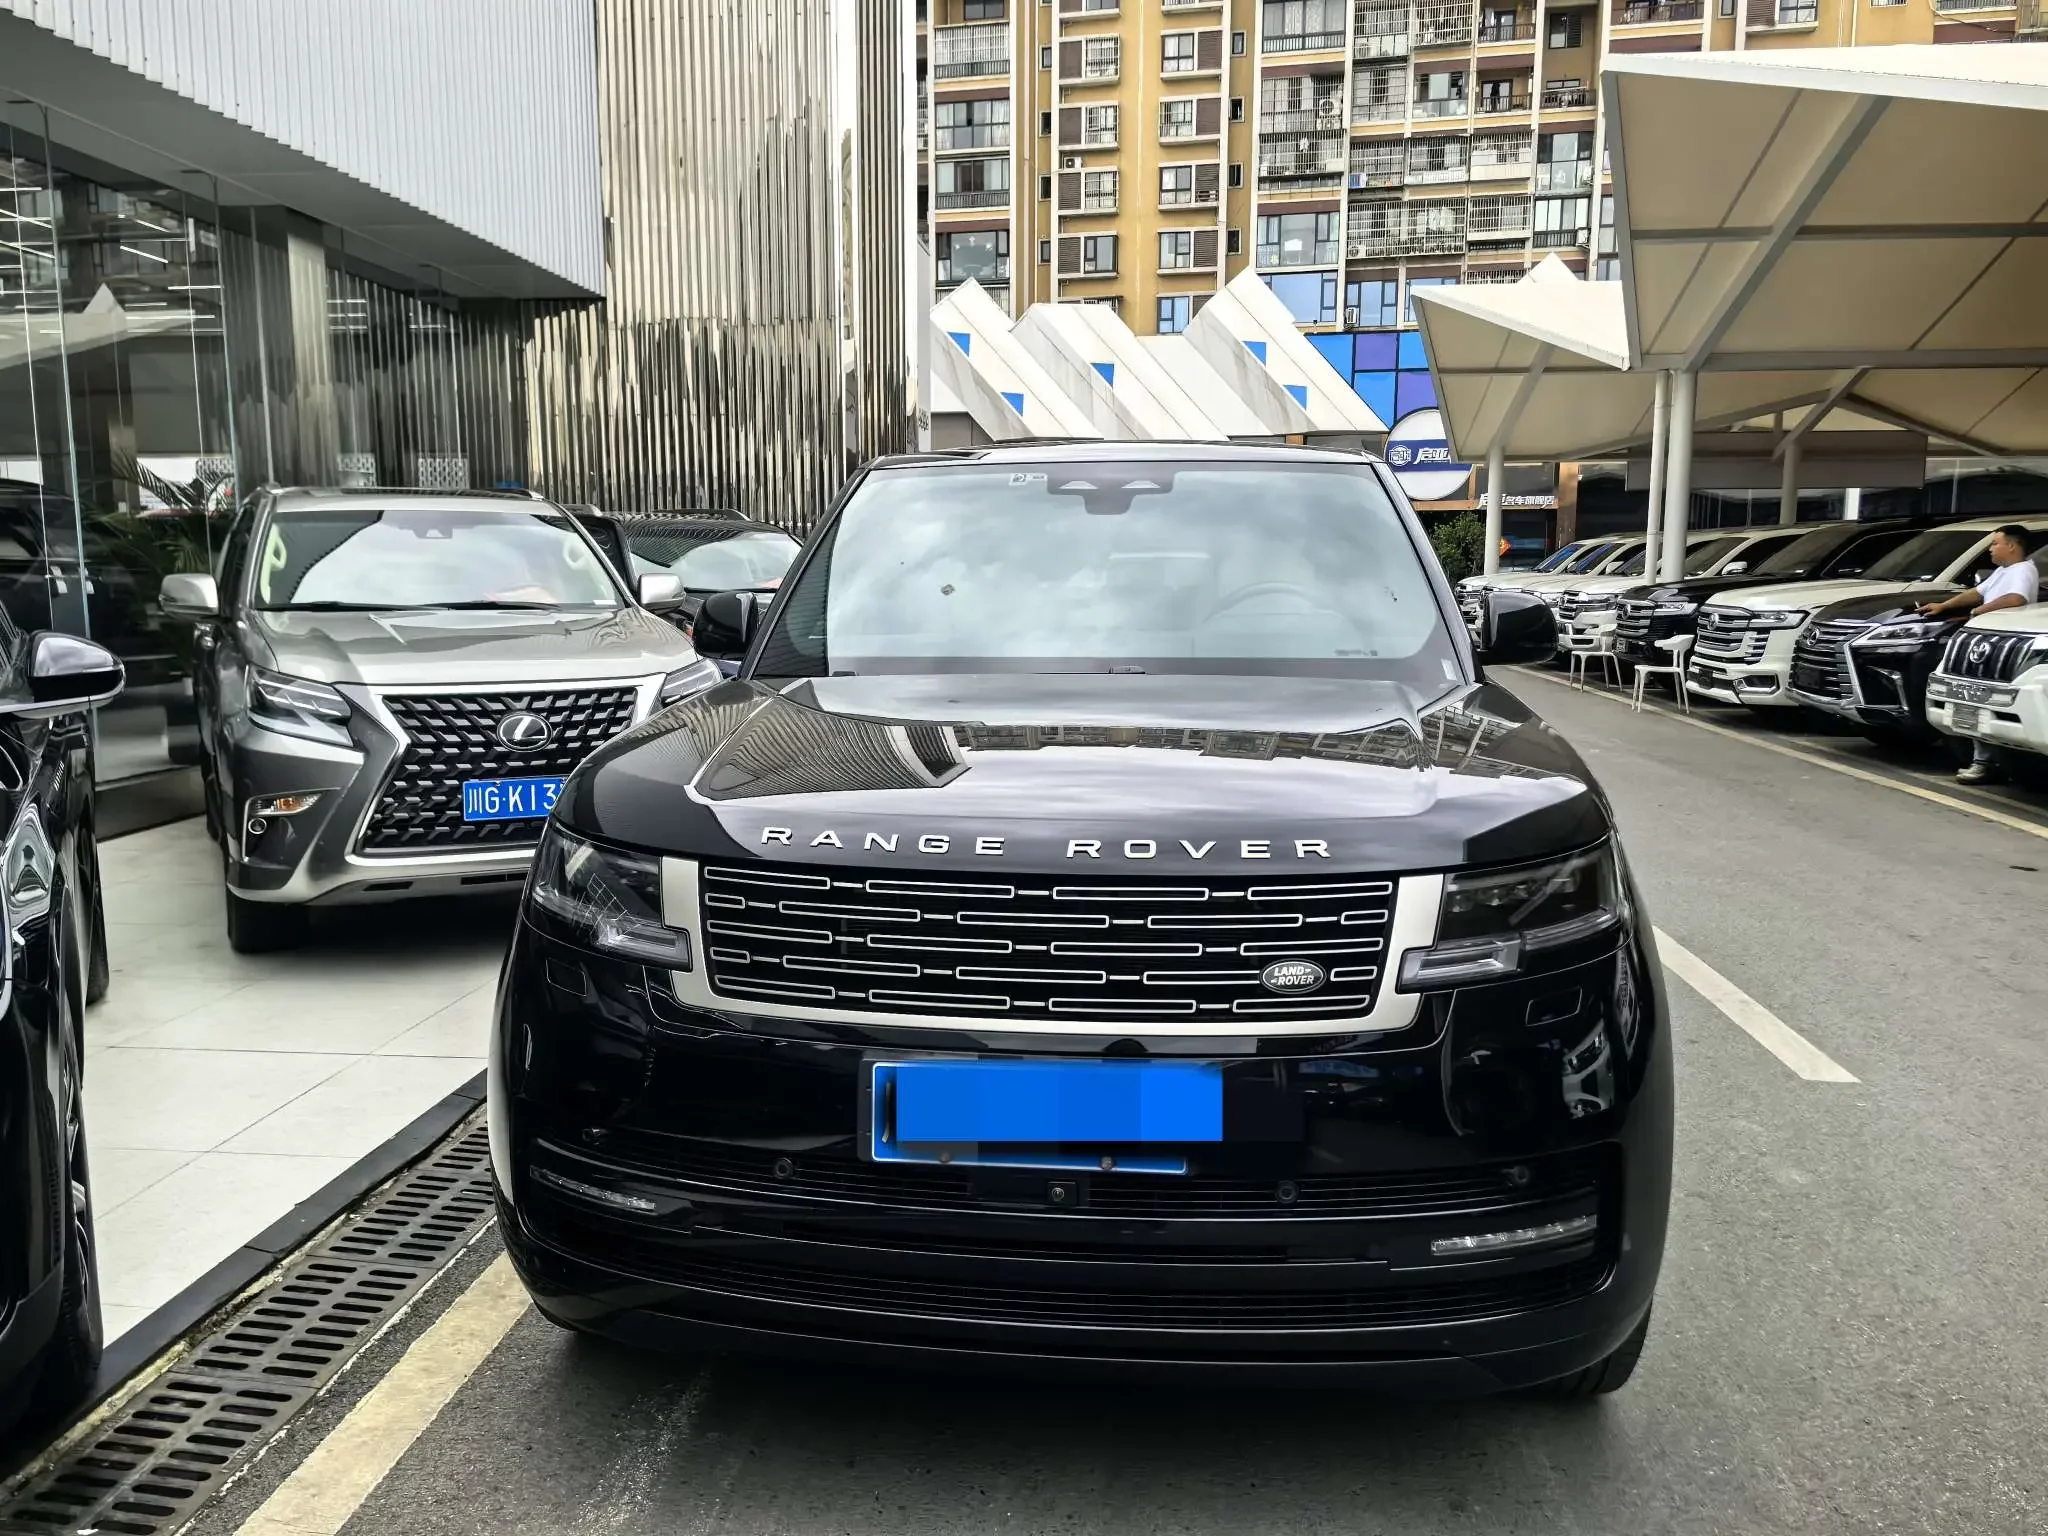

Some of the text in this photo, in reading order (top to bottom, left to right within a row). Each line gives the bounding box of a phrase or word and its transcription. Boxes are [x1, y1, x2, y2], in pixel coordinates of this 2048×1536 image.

[468, 783, 564, 814] 川G·K13
[761, 826, 1331, 859] RANGE ROVER
[1274, 966, 1305, 977] LAND
[1277, 975, 1315, 986] ROVER
